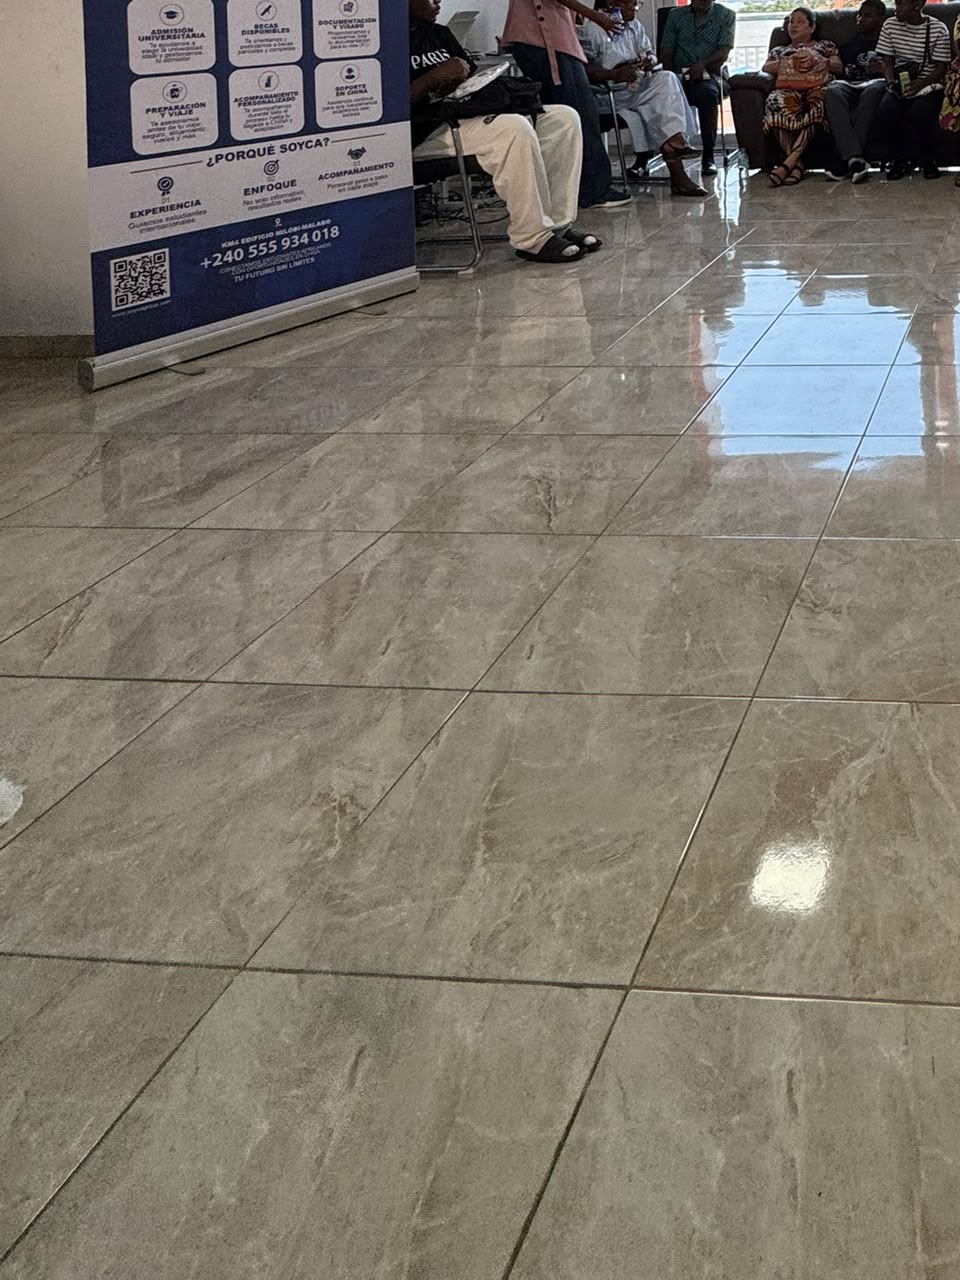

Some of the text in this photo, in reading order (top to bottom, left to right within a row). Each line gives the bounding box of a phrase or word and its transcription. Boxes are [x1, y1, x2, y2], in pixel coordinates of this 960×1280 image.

[139, 33, 205, 41] UNIVERSITARIA
[151, 27, 193, 35] ADMISIÓN
[242, 28, 290, 36] DISPONIBLES
[411, 49, 450, 69] PARIS
[234, 91, 299, 103] ACOMPAÑAMIENTO
[238, 97, 295, 107] PERSONALIZADO
[146, 102, 206, 114] PREPARACIÓN
[206, 138, 329, 167] ¿PORQUÉ SOYCA?
[318, 162, 395, 181] ACOMPAÑAMIENTO
[244, 179, 297, 196] ENFOQUE
[130, 200, 201, 219] EXPERIENCIA
[241, 232, 273, 244] EDIFICIO
[200, 226, 339, 268] +240 555 934 018
[246, 267, 275, 279] FUTURO
[276, 264, 288, 272] SIN
